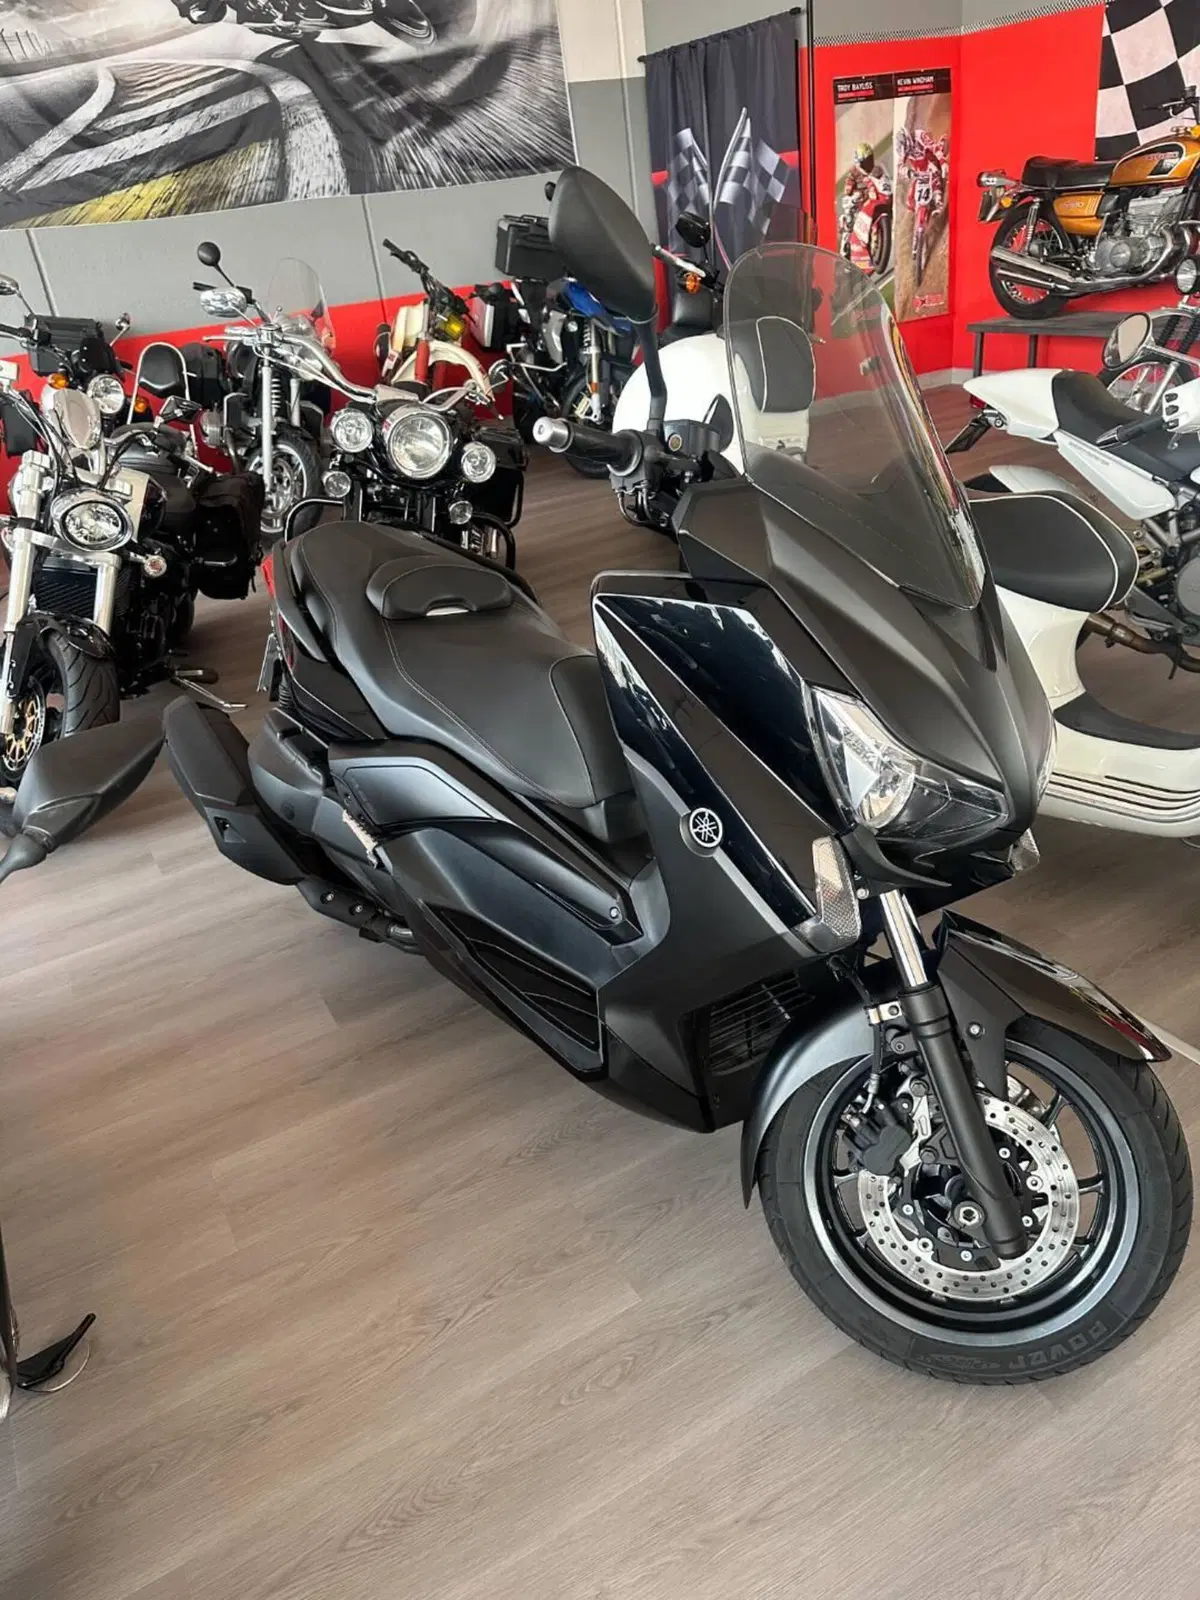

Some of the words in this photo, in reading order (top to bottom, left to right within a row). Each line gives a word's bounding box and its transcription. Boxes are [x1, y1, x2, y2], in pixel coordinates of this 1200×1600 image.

[837, 84, 851, 92] TROY
[852, 82, 873, 91] BAYLISS
[917, 187, 930, 202] 14
